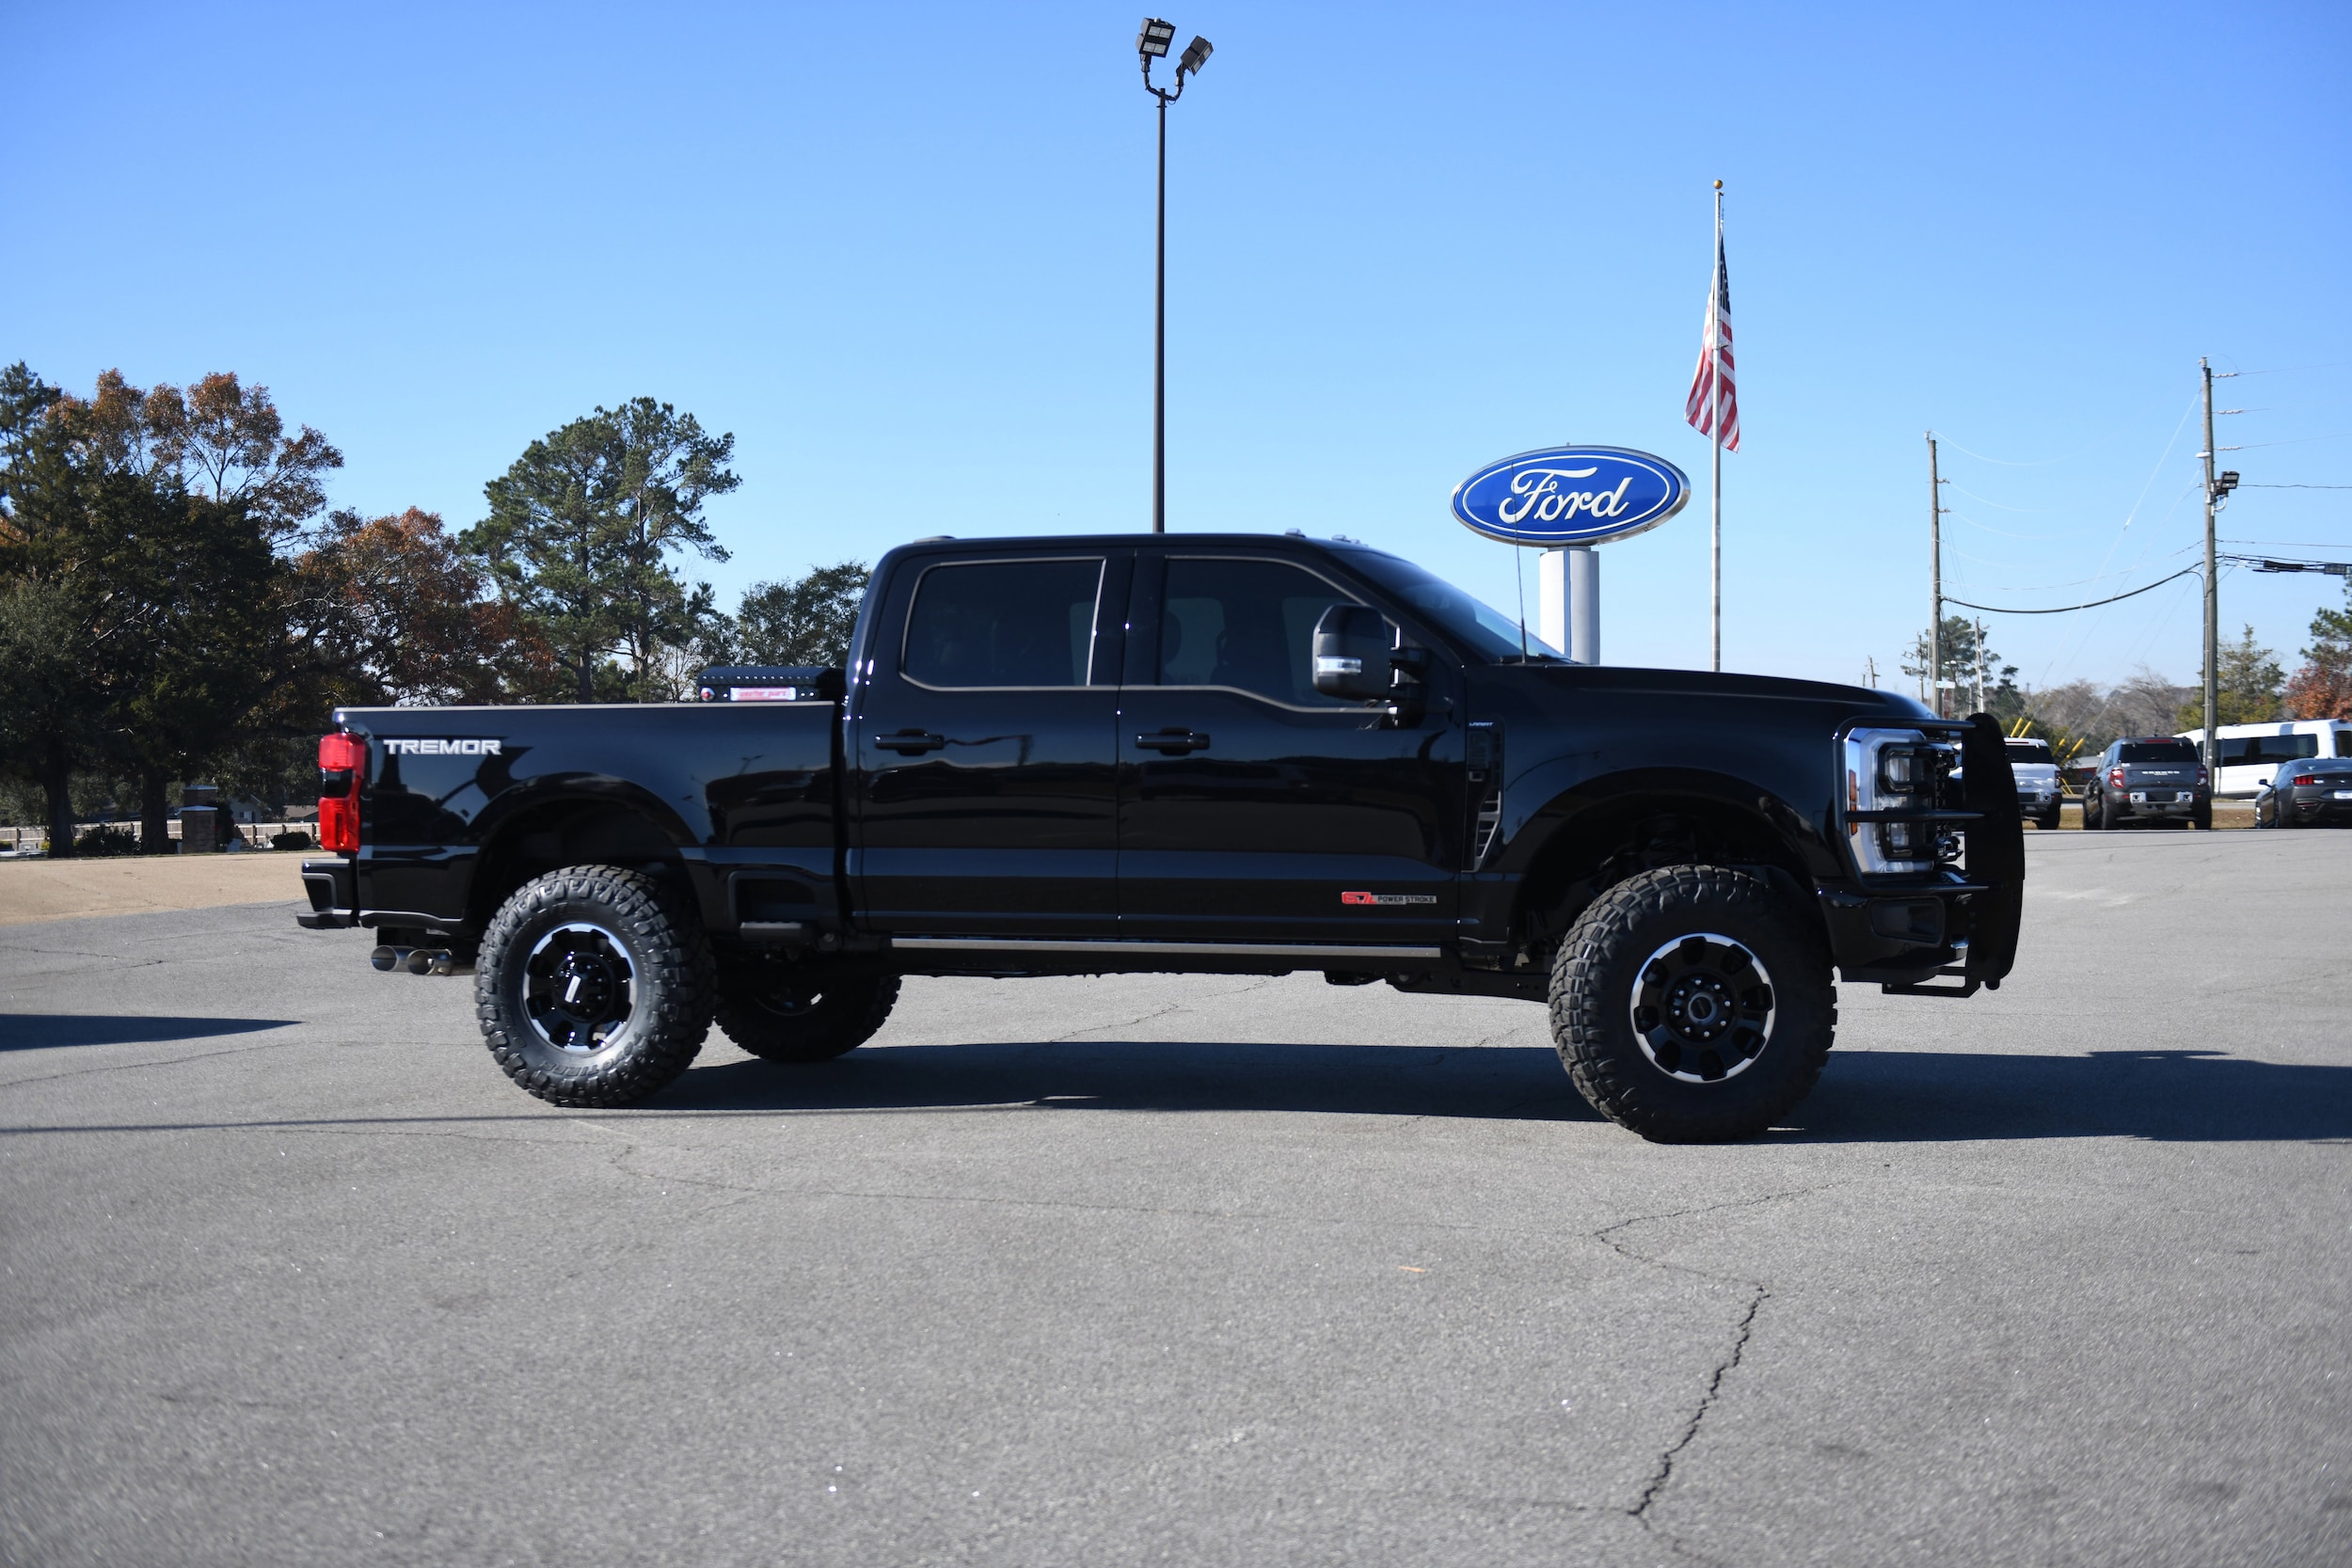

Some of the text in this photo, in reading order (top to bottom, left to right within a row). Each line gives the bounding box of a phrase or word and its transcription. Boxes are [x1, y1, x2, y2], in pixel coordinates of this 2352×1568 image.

[1499, 466, 1634, 524] Ford
[383, 739, 502, 755] TREMOR
[1405, 895, 1435, 904] STROKE
